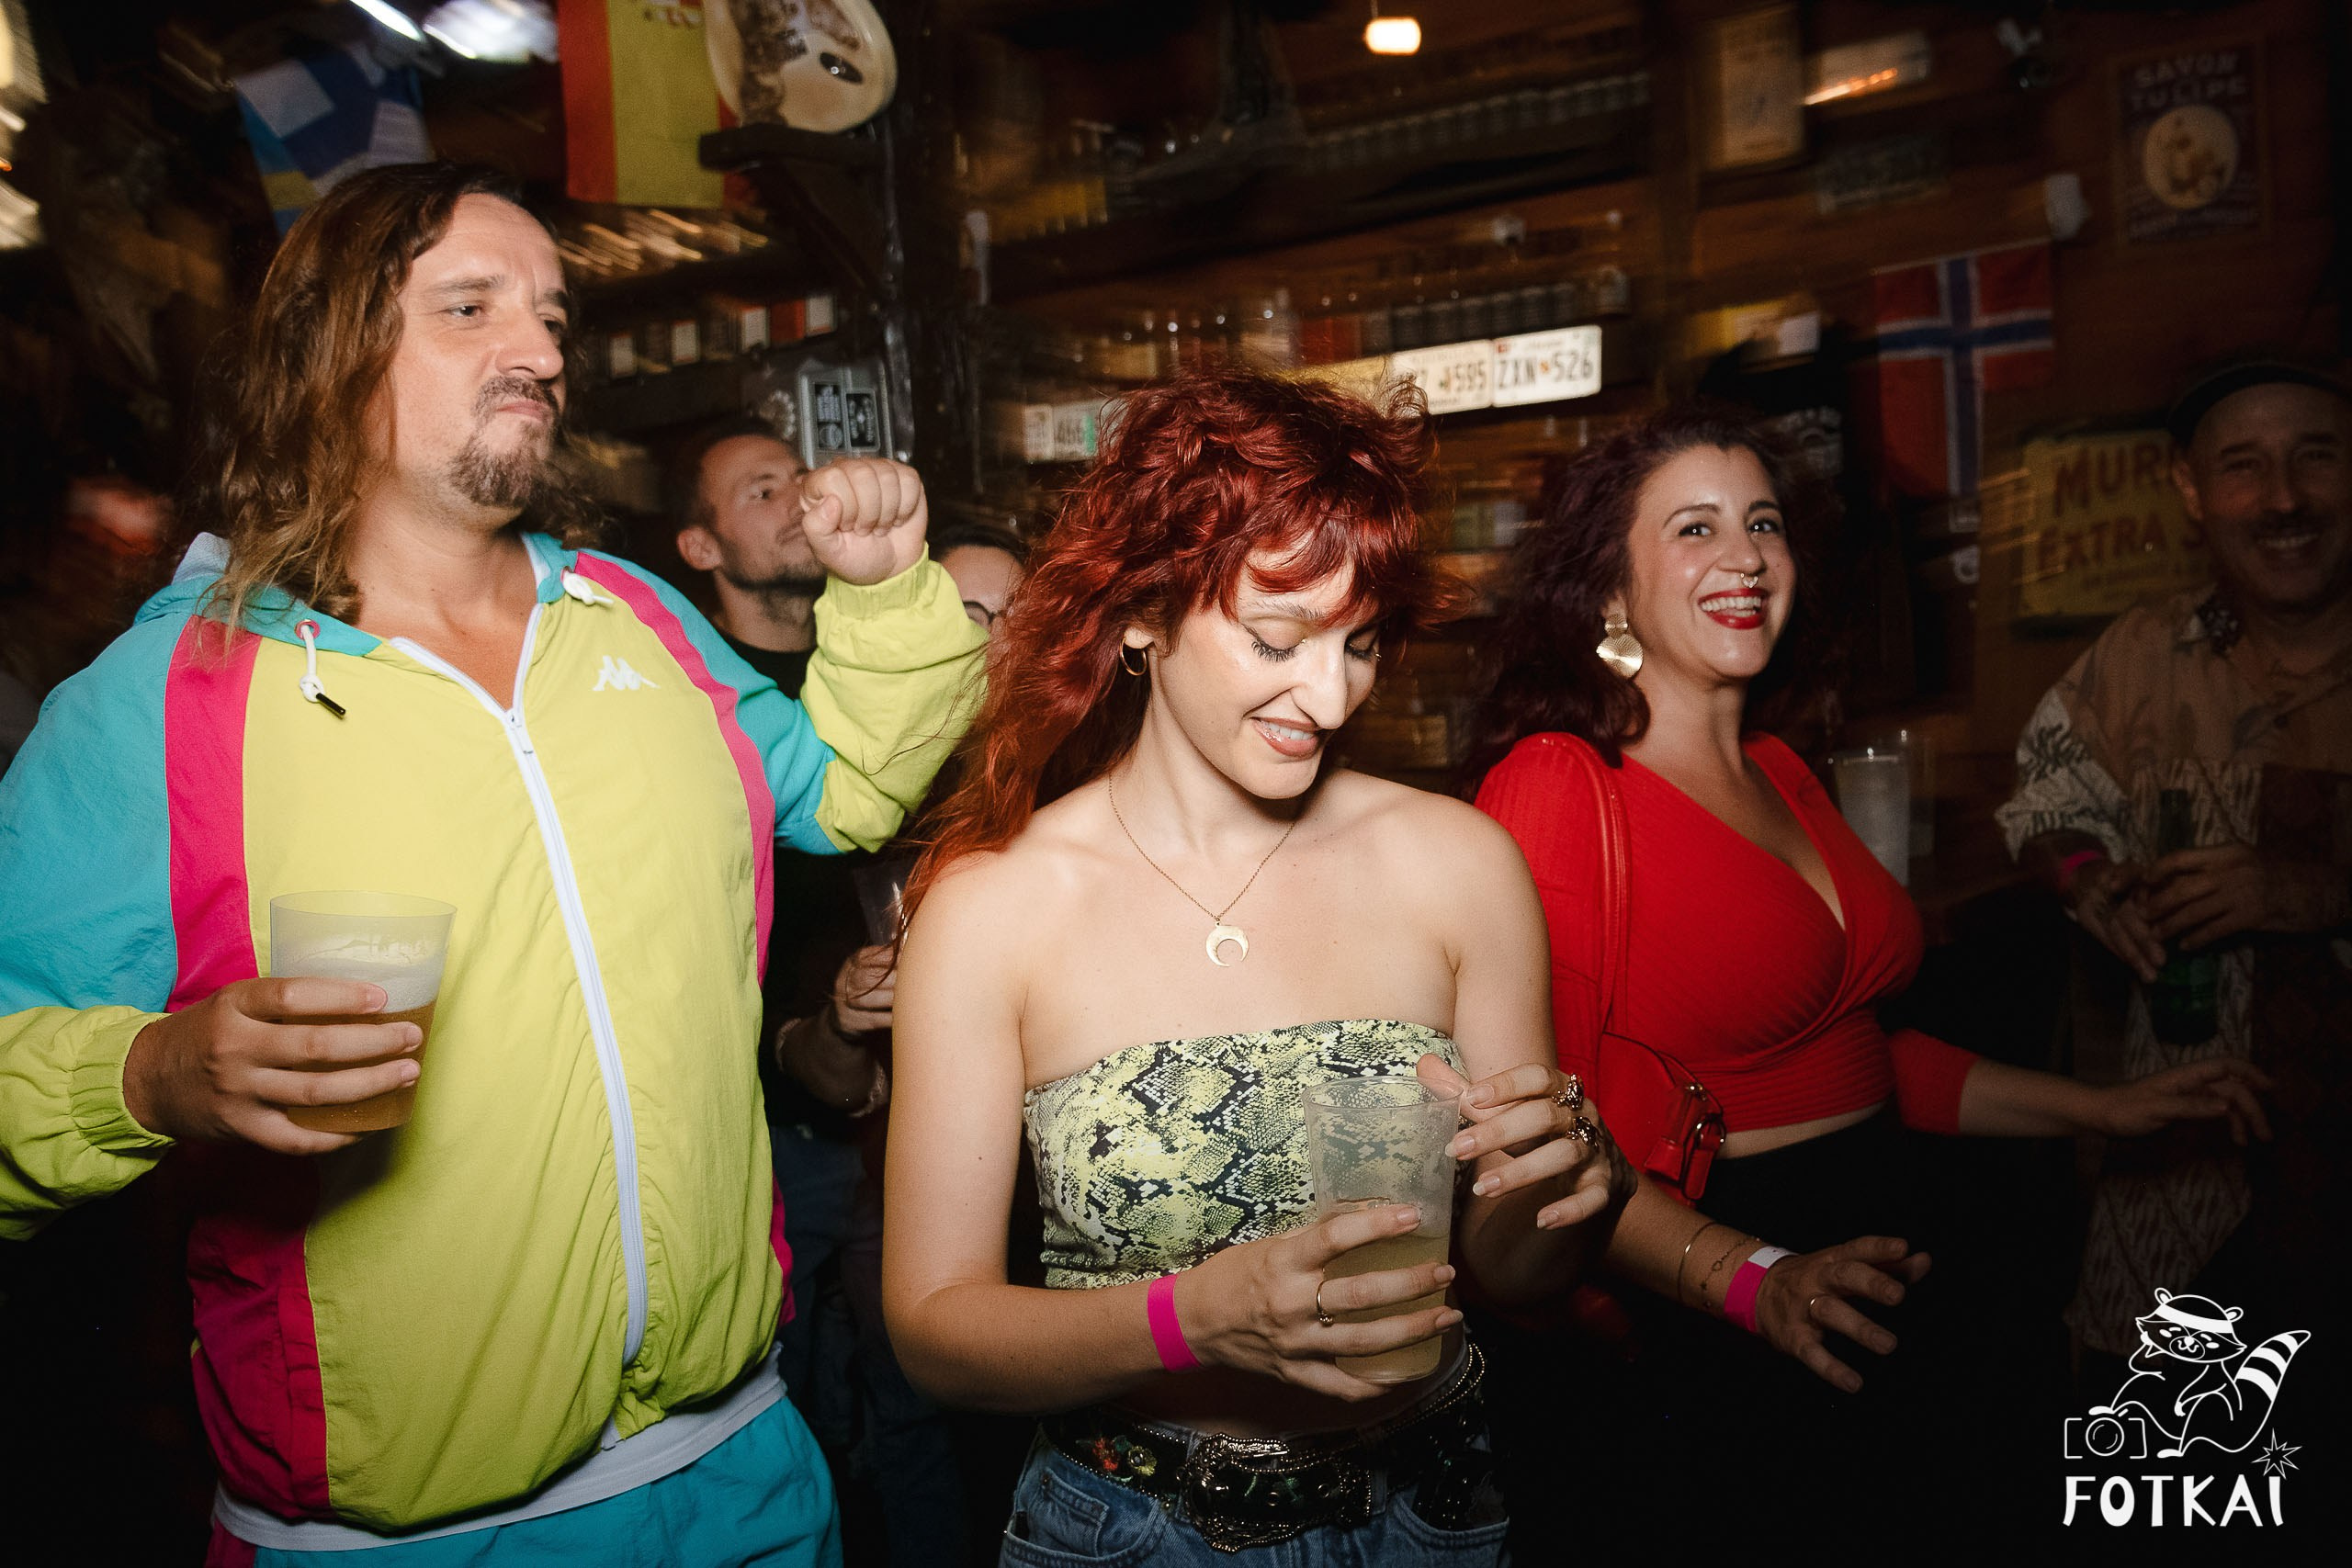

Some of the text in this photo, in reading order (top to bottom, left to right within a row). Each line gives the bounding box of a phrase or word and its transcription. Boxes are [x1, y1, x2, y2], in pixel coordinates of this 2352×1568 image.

[2134, 52, 2239, 88] SAVON
[2130, 76, 2248, 111] TULIPE
[1552, 347, 1594, 382] 526
[2038, 510, 2166, 571] EXTRA
